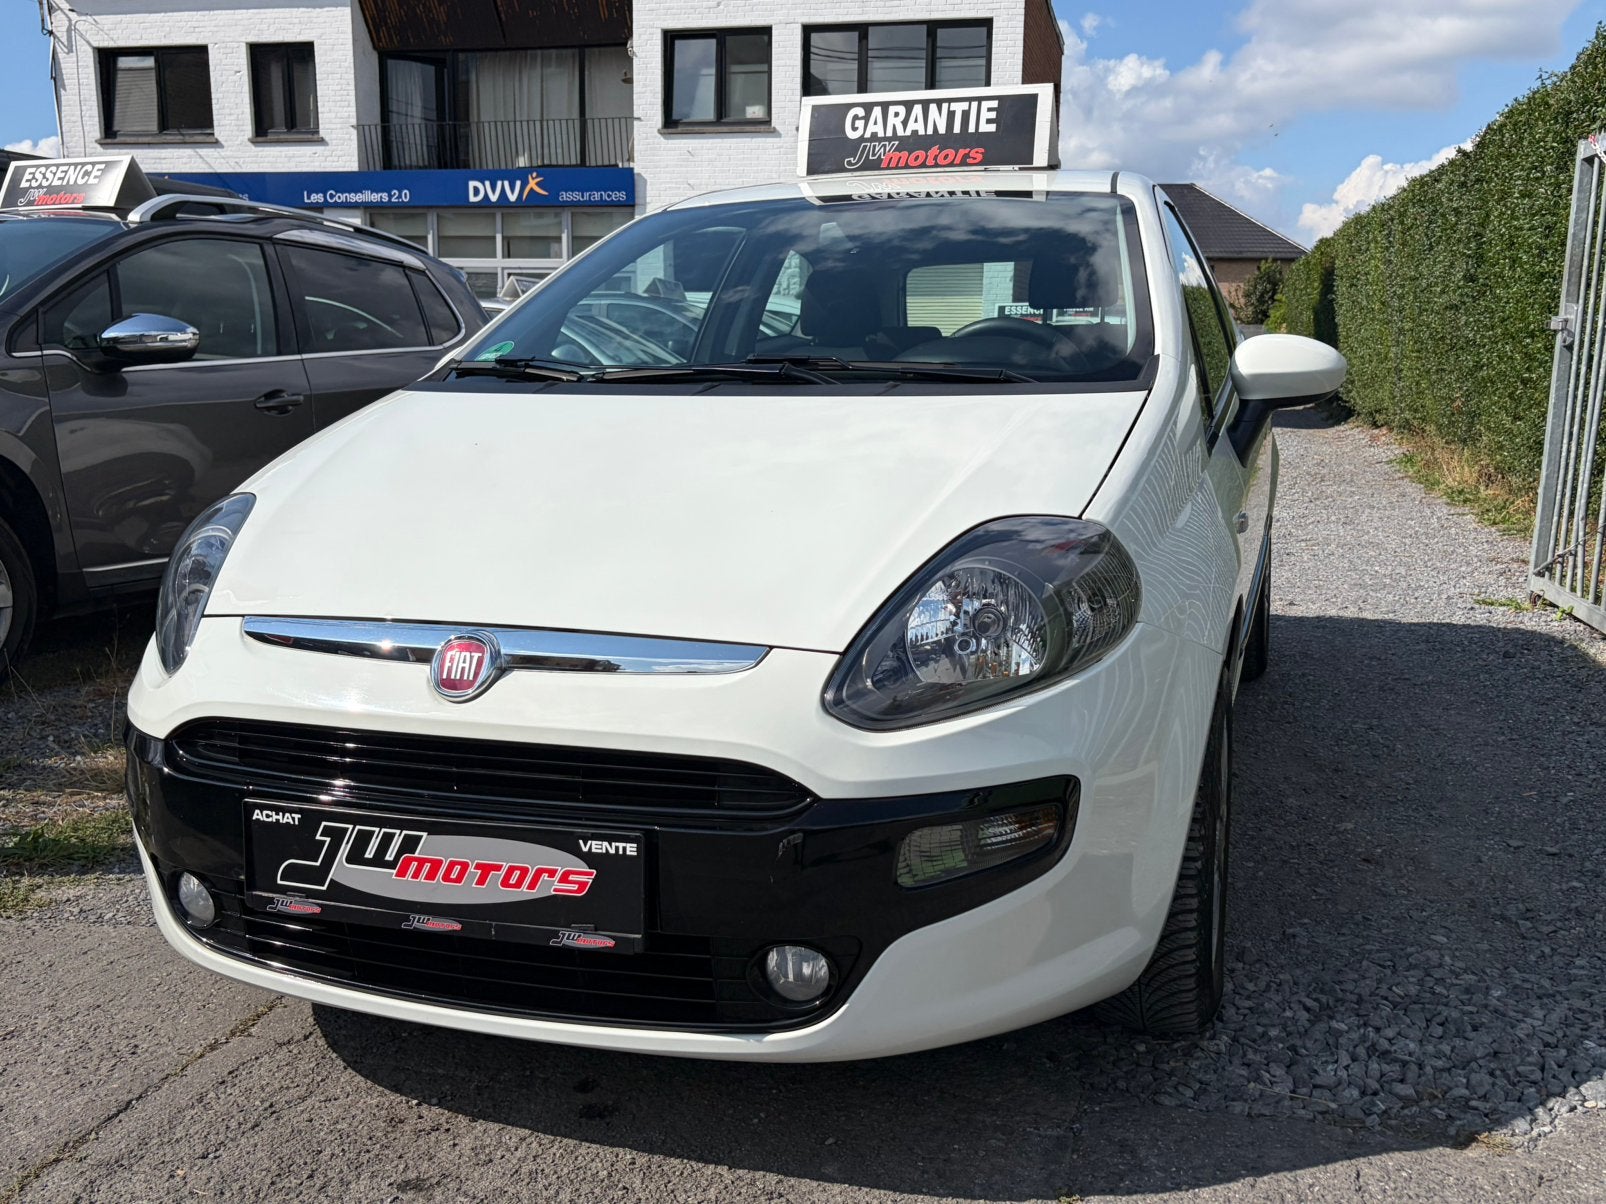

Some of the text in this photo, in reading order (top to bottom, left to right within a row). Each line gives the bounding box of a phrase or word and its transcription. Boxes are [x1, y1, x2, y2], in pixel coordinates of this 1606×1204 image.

[845, 100, 998, 139] GARANTIE
[880, 145, 985, 168] motors
[20, 164, 105, 188] ESSENCE
[34, 191, 86, 205] motors
[304, 190, 410, 203] Les Conseillers 2.0
[468, 180, 626, 202] DVV assurances
[442, 650, 482, 680] FIAT
[252, 809, 301, 825] ACHAT
[277, 821, 428, 890] JW
[579, 840, 637, 855] VENTE
